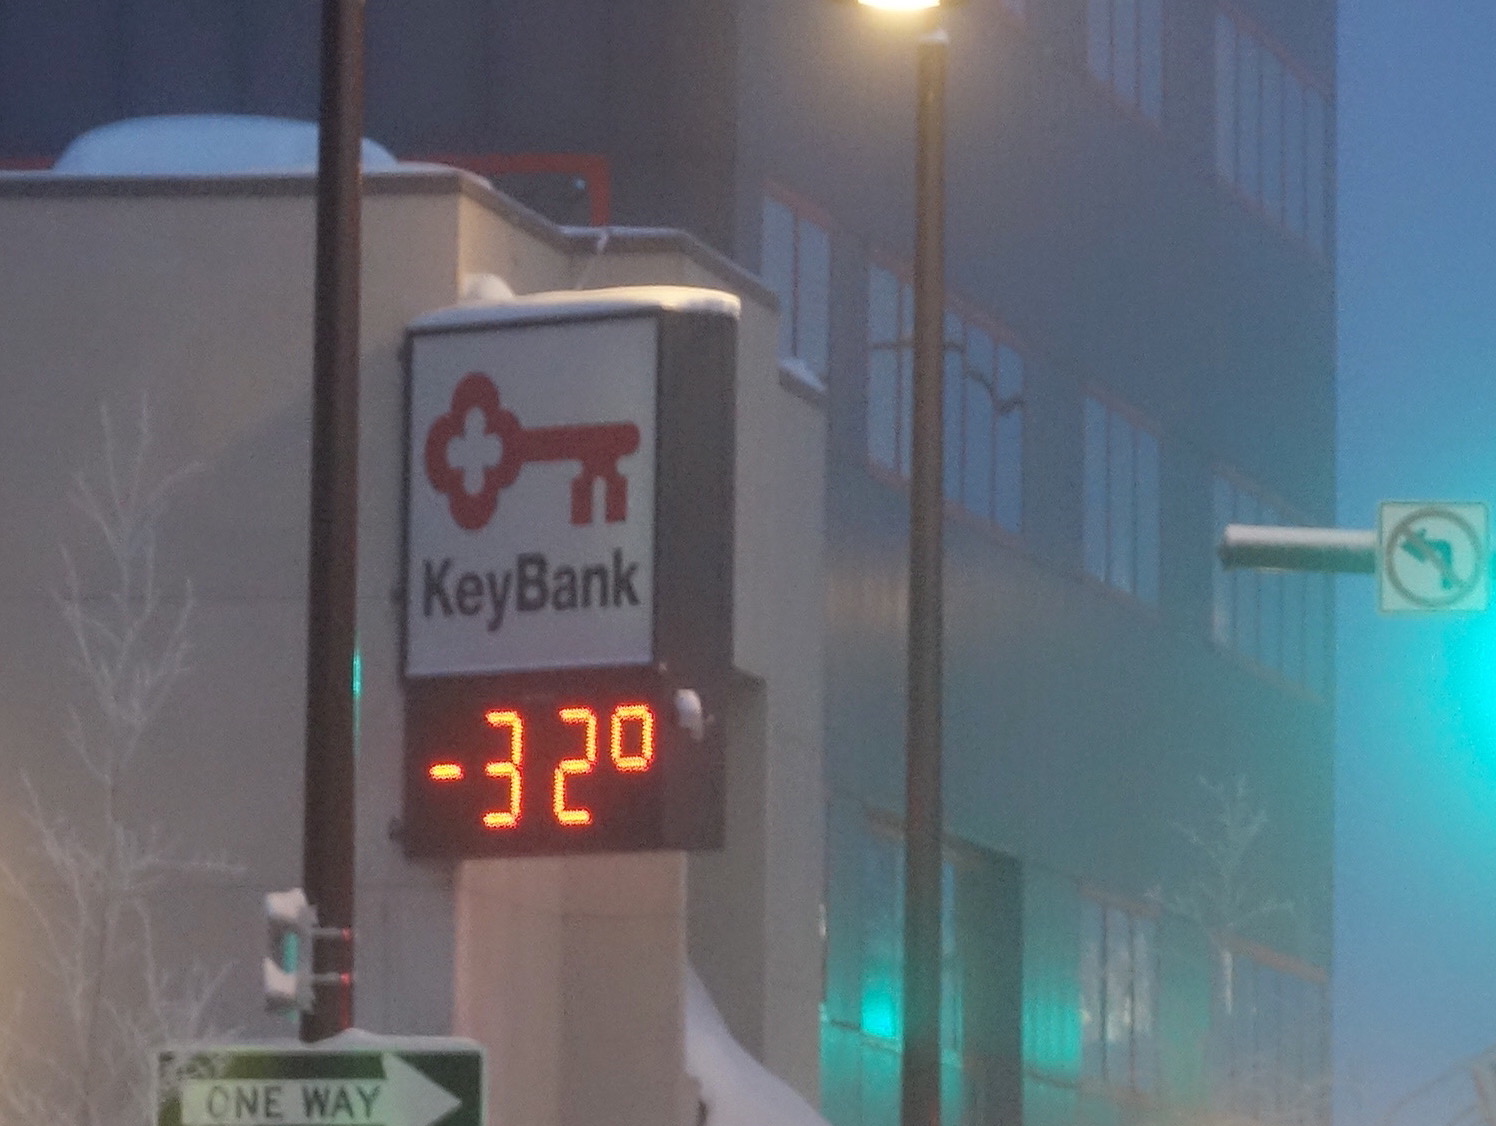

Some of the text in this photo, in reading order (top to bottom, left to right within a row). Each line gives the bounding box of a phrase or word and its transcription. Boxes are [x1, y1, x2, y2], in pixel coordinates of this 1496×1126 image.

[422, 547, 642, 633] KeyBank
[206, 1085, 381, 1120] ONE WAY
